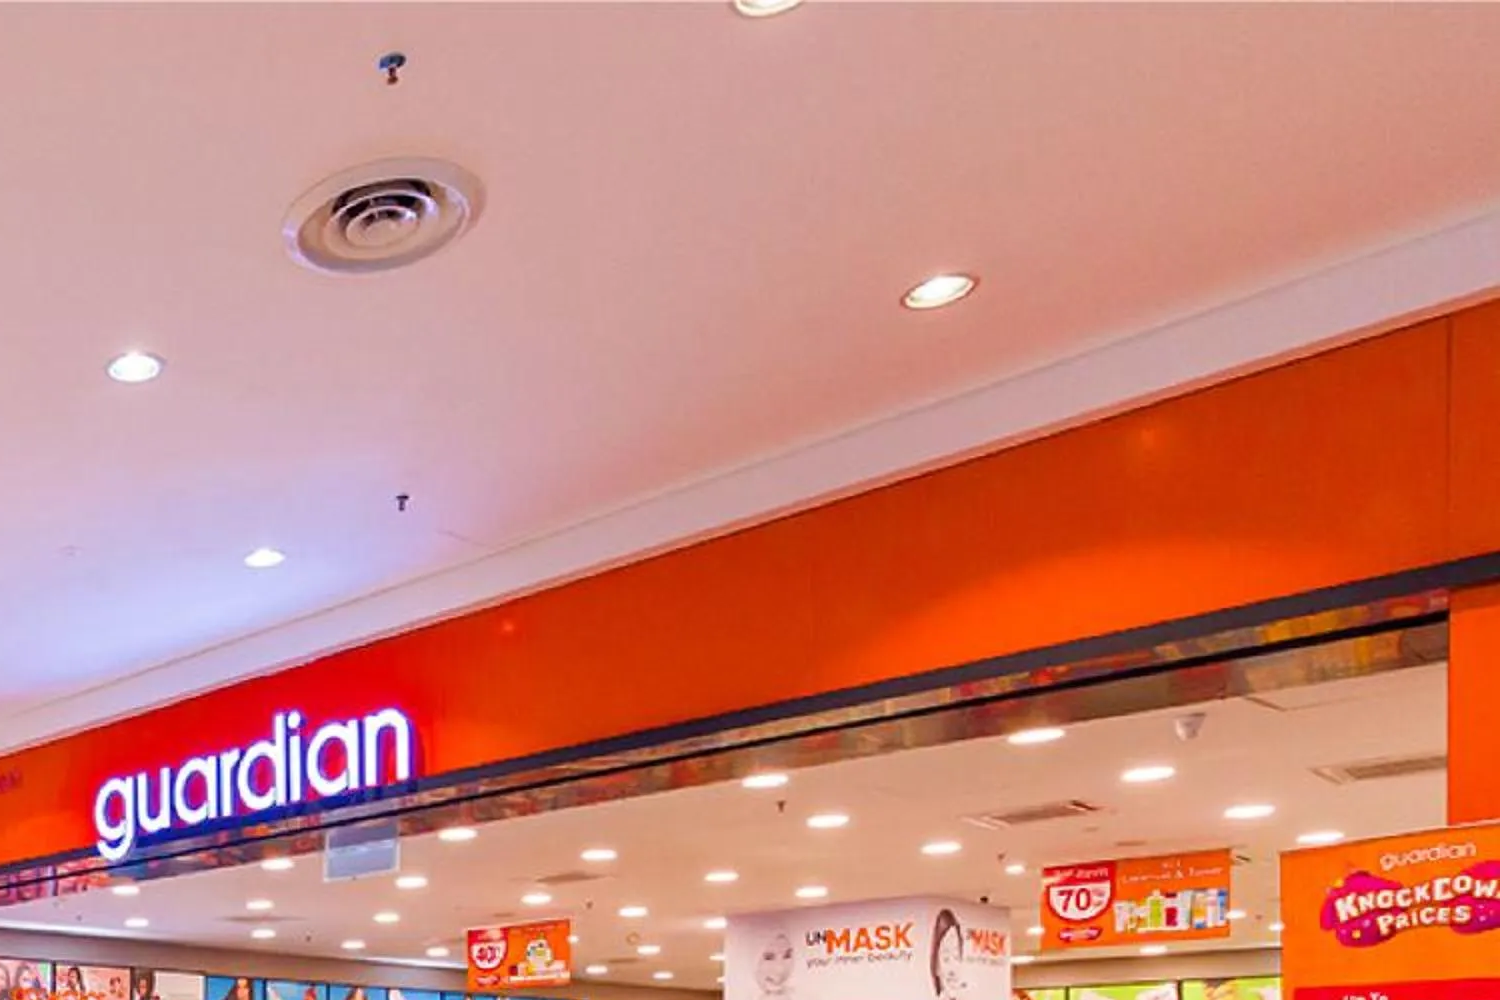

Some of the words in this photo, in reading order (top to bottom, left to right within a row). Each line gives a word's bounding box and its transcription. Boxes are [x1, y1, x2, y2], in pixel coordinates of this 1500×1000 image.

[94, 706, 412, 862] guardian
[1379, 841, 1477, 871] guardian
[1376, 904, 1472, 936] PRICES
